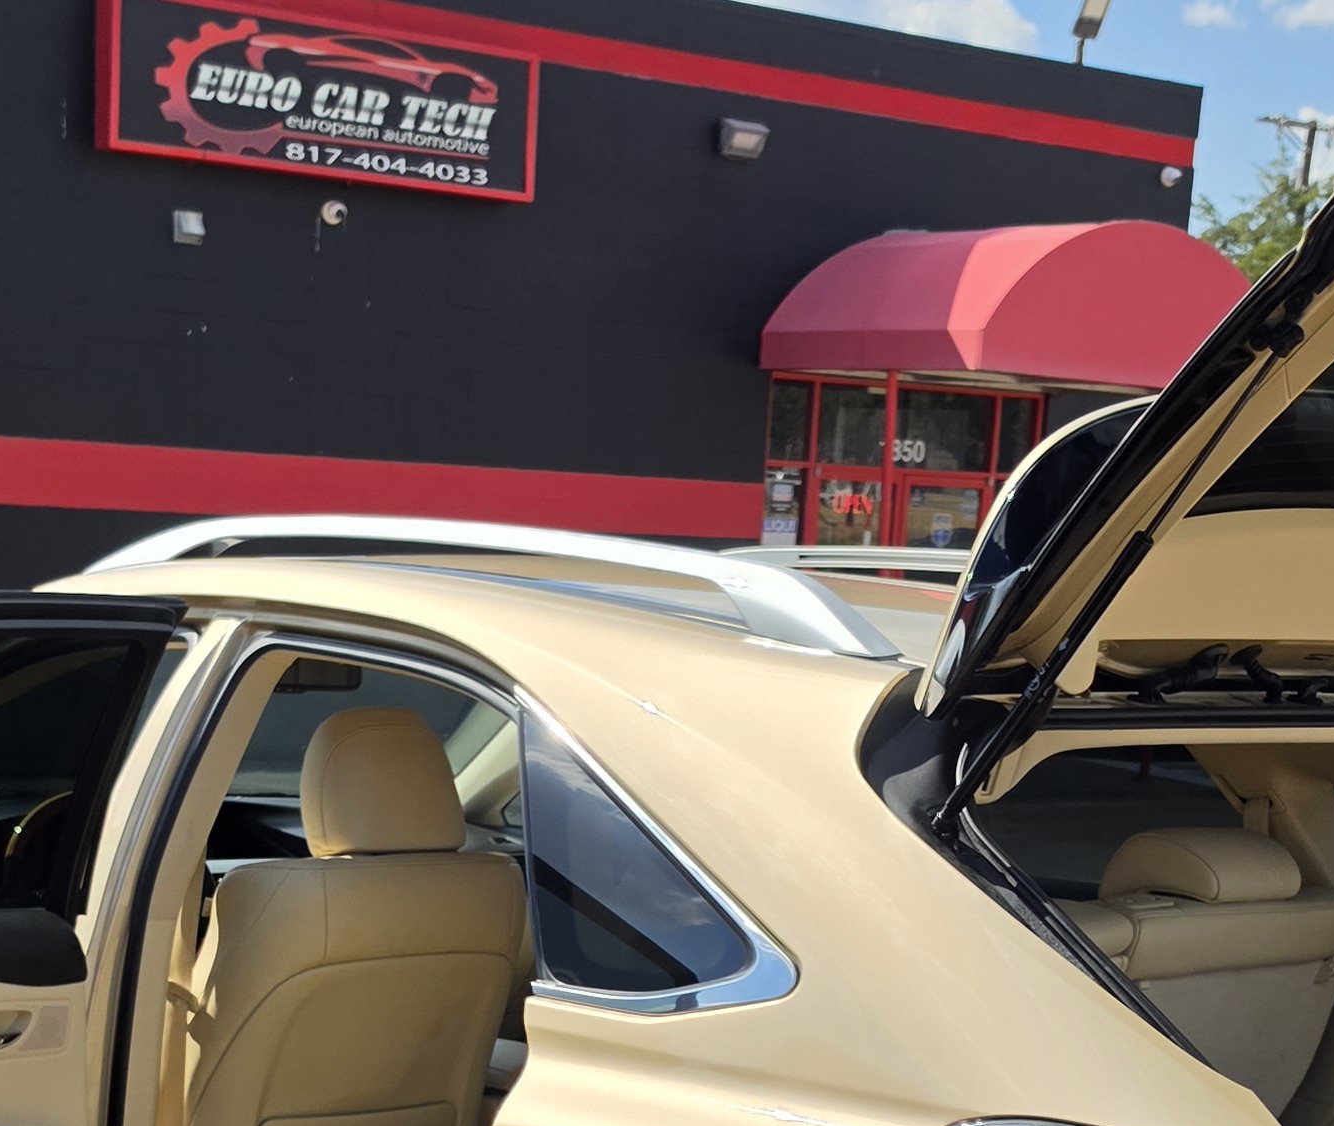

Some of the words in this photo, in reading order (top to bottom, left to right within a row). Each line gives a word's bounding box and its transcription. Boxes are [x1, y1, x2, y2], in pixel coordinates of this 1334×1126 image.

[190, 63, 303, 113] EURO
[311, 82, 391, 126] CAR
[399, 94, 497, 141] TECH
[285, 114, 379, 139] european
[382, 128, 490, 156] automotive
[285, 143, 489, 186] 817-404-4033
[832, 494, 873, 515] OPEN
